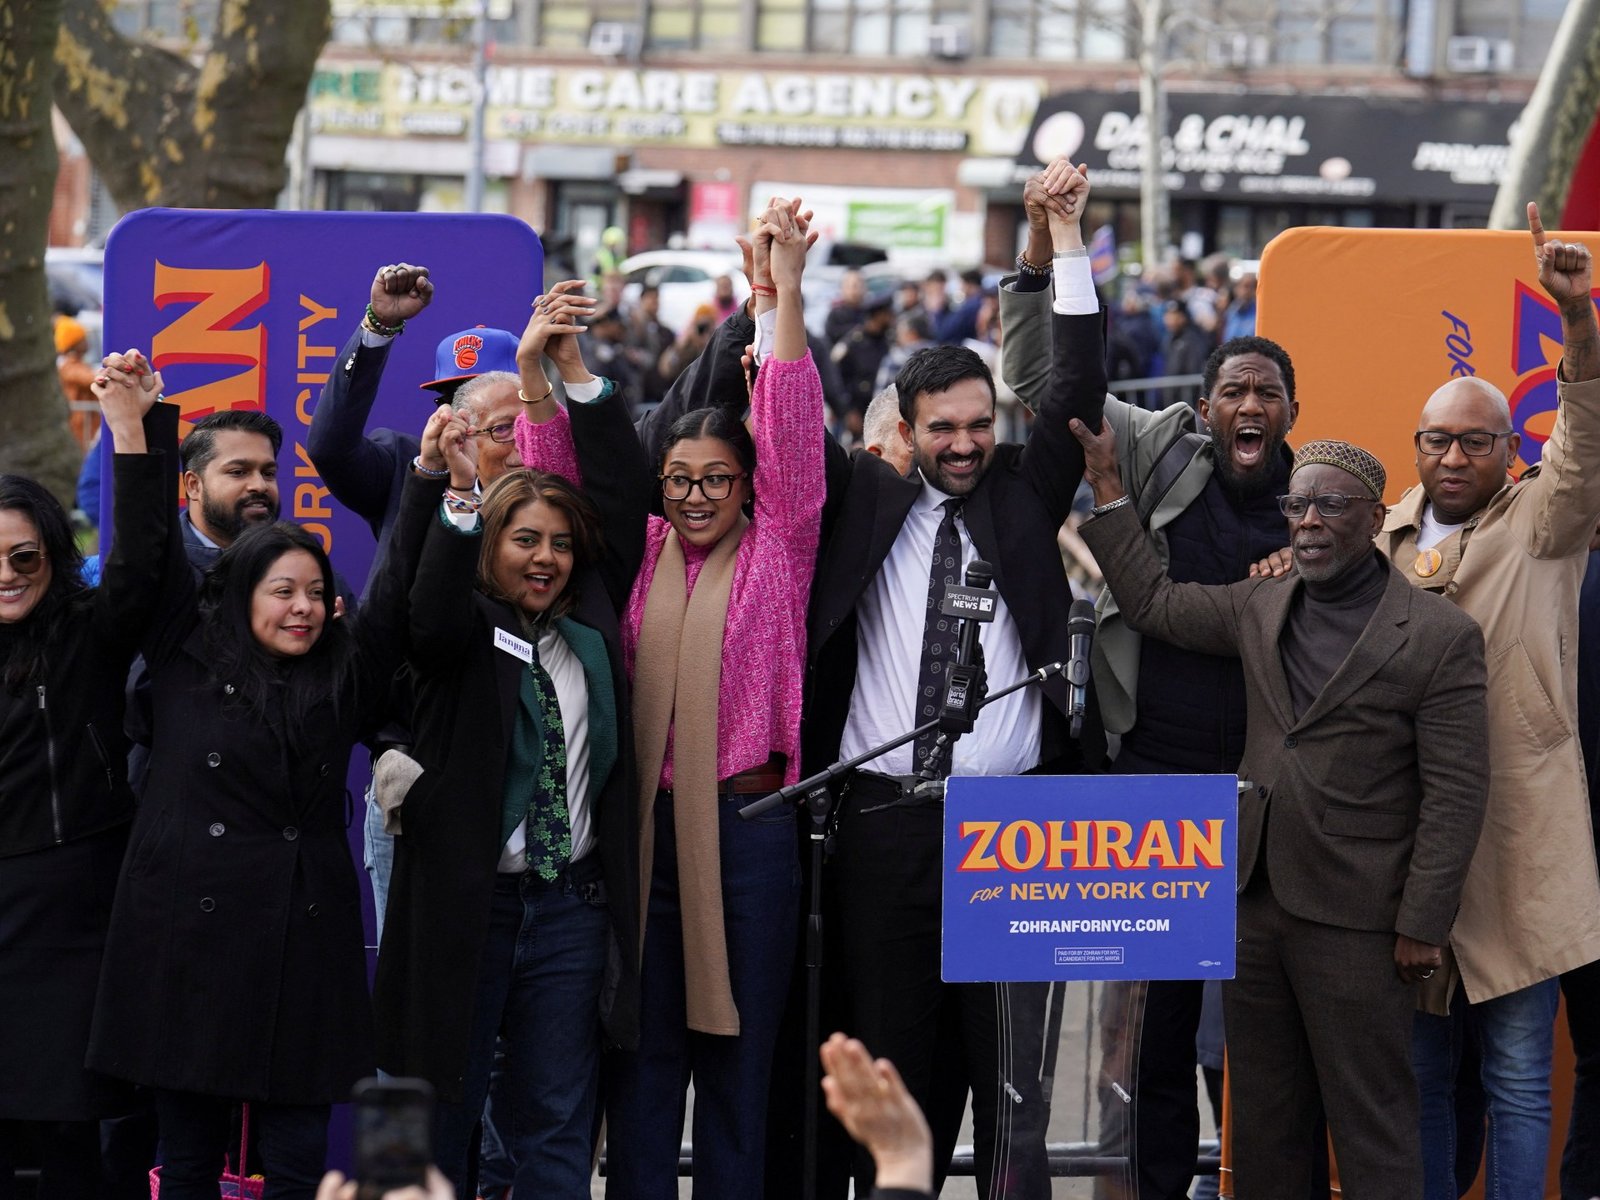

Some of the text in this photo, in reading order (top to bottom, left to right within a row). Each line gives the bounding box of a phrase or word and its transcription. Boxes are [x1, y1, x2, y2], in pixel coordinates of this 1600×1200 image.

[568, 67, 718, 113] CARE
[732, 73, 979, 119] AGENCY
[1094, 111, 1172, 151] DA
[455, 335, 483, 351] KNICKS
[1441, 310, 1476, 377] FOR
[295, 294, 338, 426] CITY
[947, 592, 979, 603] SPECTRUM
[952, 600, 978, 610] NEWS
[957, 819, 1226, 873] ZOHRAN
[970, 881, 1211, 904] FOR NEW YORK CITY
[1009, 919, 1170, 934] ZOHRANFORNYC.COM
